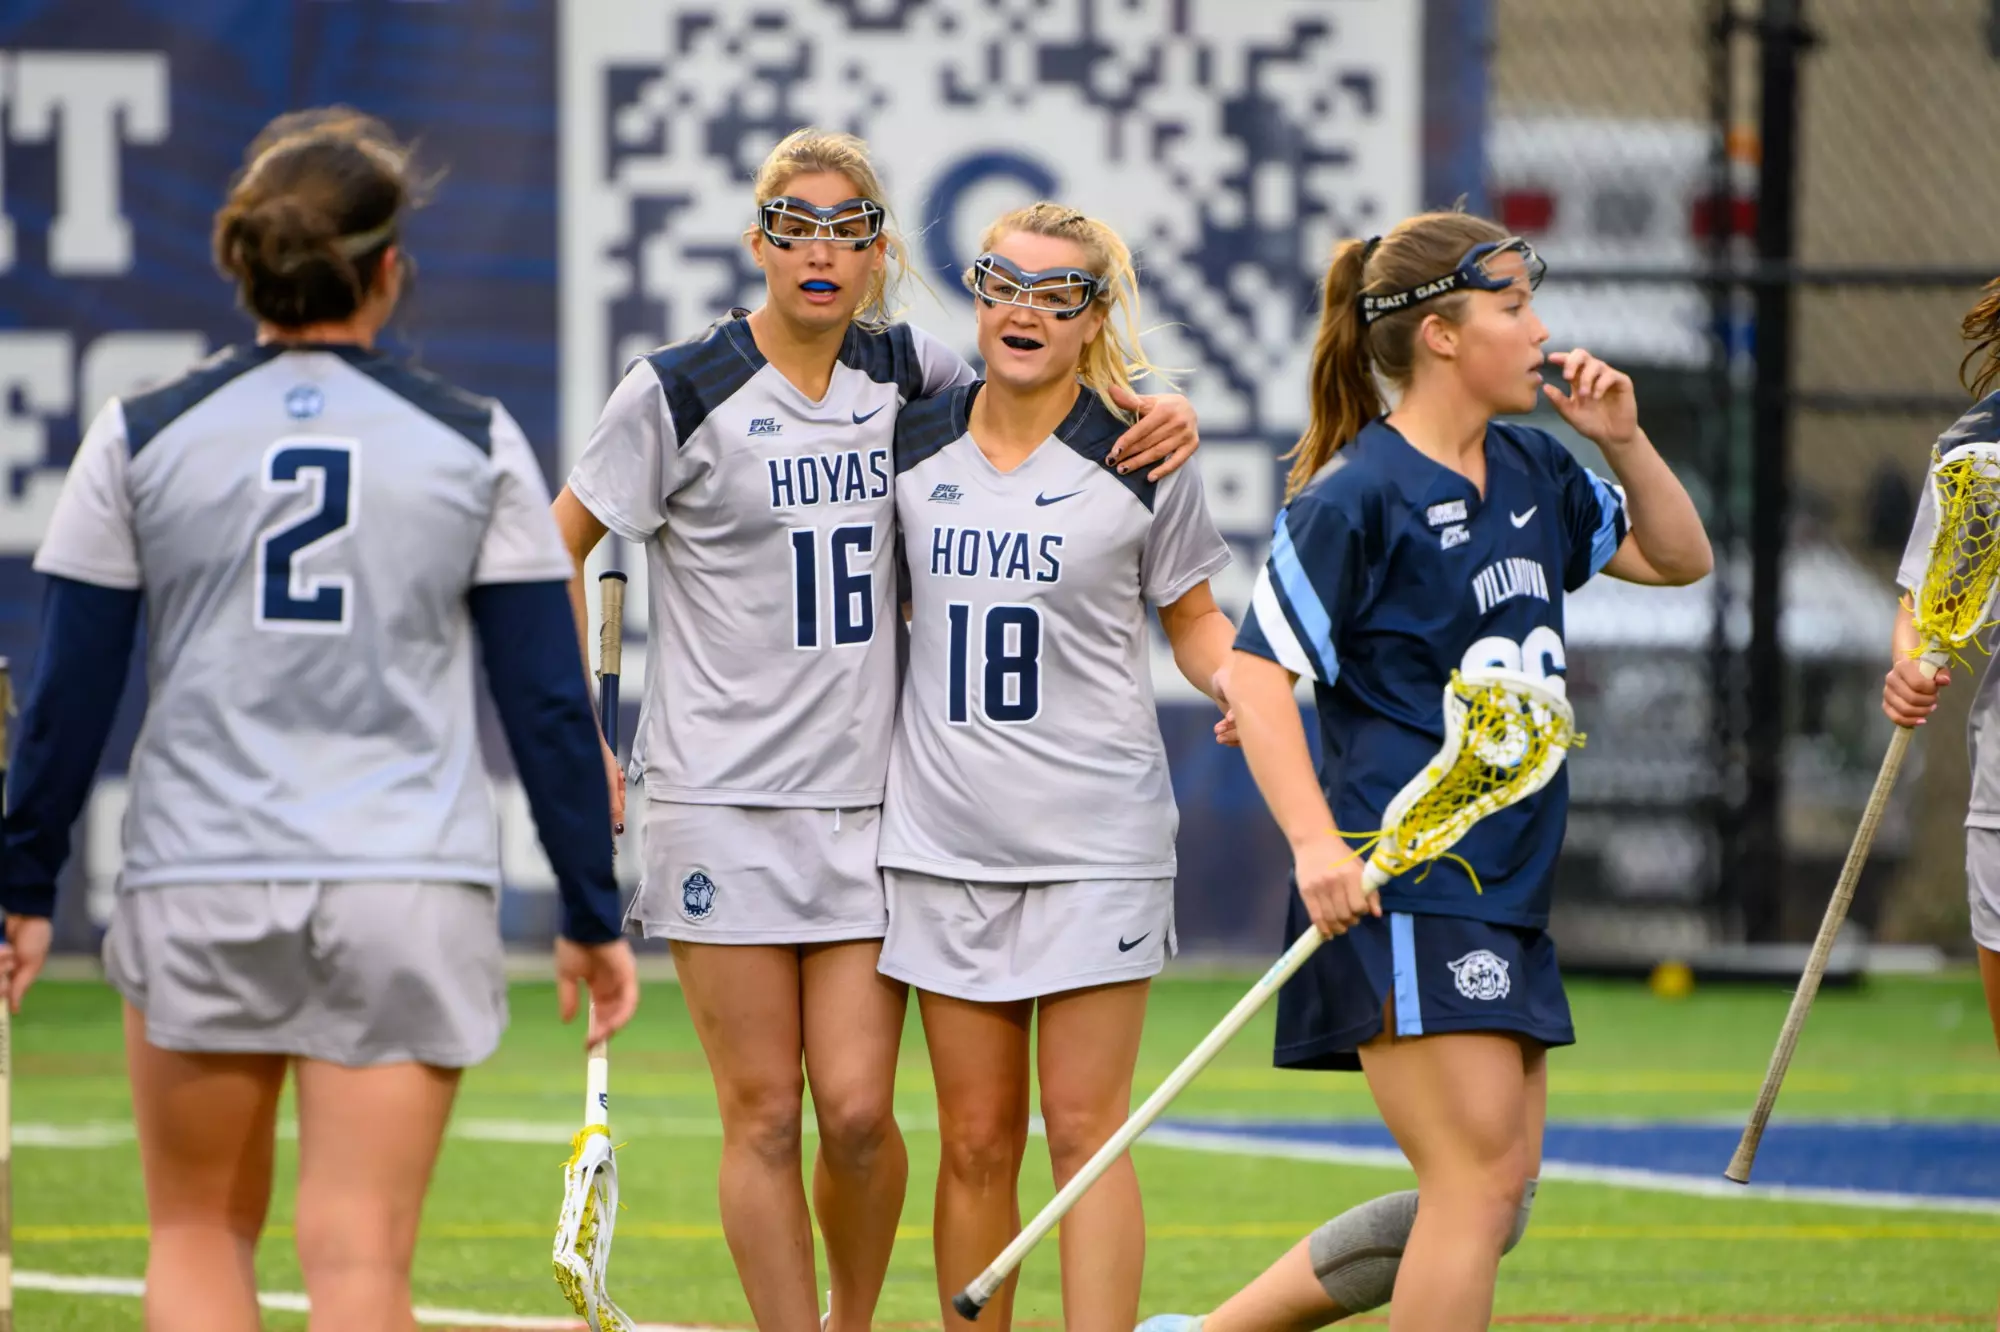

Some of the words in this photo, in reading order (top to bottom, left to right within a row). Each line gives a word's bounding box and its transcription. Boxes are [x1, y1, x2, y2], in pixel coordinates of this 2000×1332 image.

[1376, 292, 1409, 309] GAIT
[1414, 275, 1456, 300] GAIT
[749, 424, 784, 432] EAST
[750, 417, 775, 426] BIG
[767, 448, 889, 508] HOYAS
[930, 490, 965, 500] EAST
[934, 483, 960, 493] BIG
[256, 436, 360, 632] 2
[930, 525, 1066, 584] HOYAS
[789, 522, 876, 650] 16
[946, 601, 1043, 725] 18
